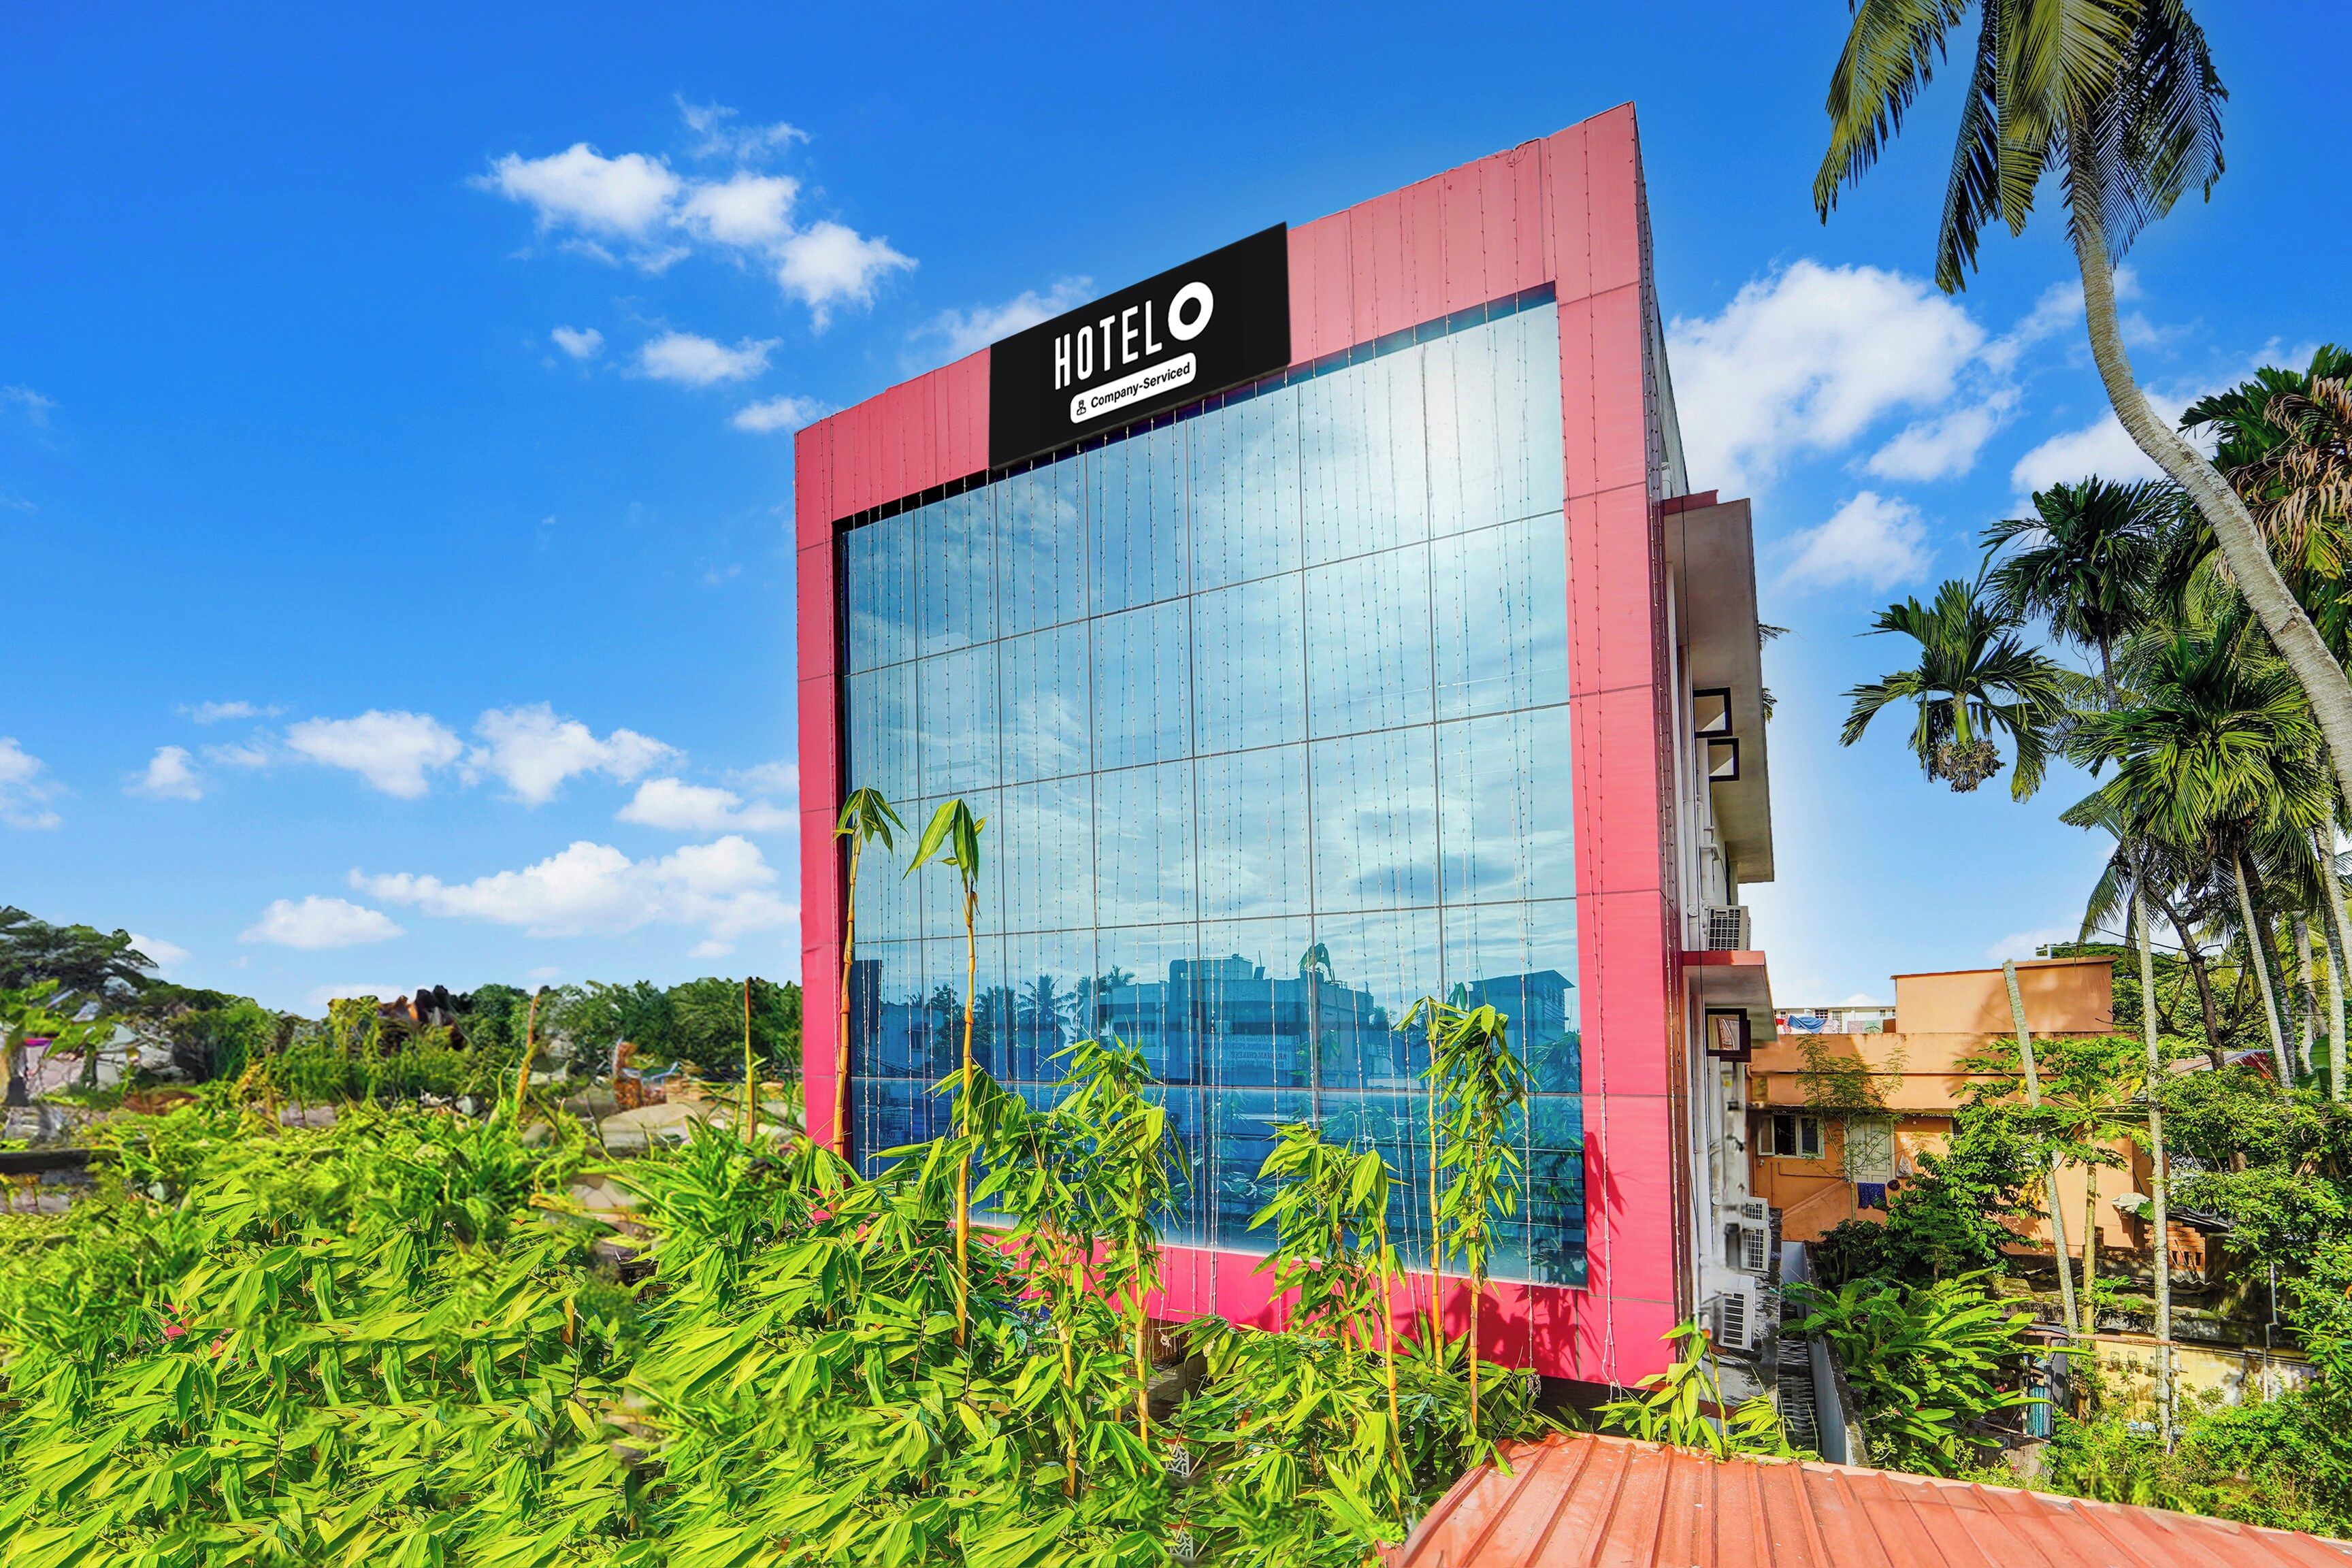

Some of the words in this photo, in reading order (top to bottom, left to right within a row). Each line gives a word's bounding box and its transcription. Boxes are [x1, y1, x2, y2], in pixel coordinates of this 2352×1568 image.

[1055, 300, 1162, 390] HOTEL
[1168, 281, 1213, 341] O
[1090, 362, 1190, 408] Company-Serviced
